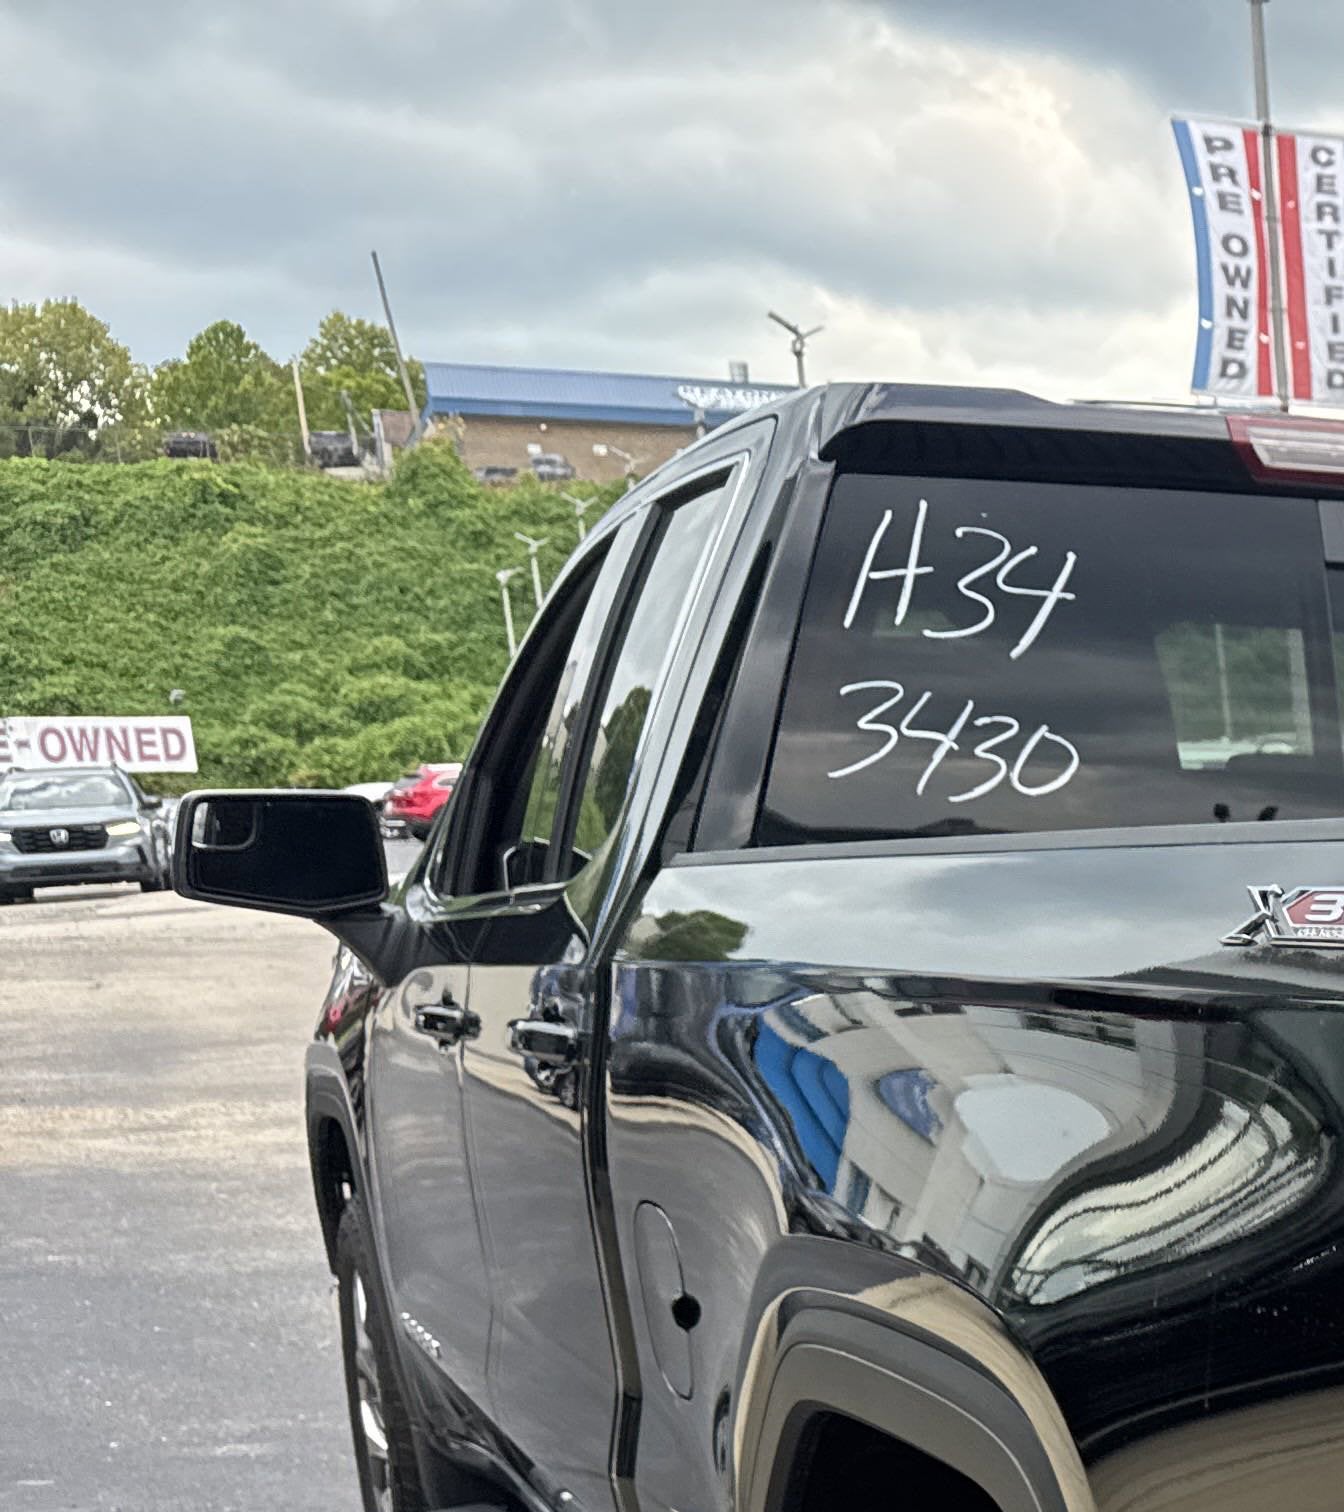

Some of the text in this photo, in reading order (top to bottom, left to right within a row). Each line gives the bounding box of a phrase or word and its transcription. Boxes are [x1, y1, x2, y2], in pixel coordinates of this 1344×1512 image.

[1203, 135, 1251, 380] PRE OWNED
[843, 499, 1078, 660] H34
[828, 680, 1080, 803] 3430
